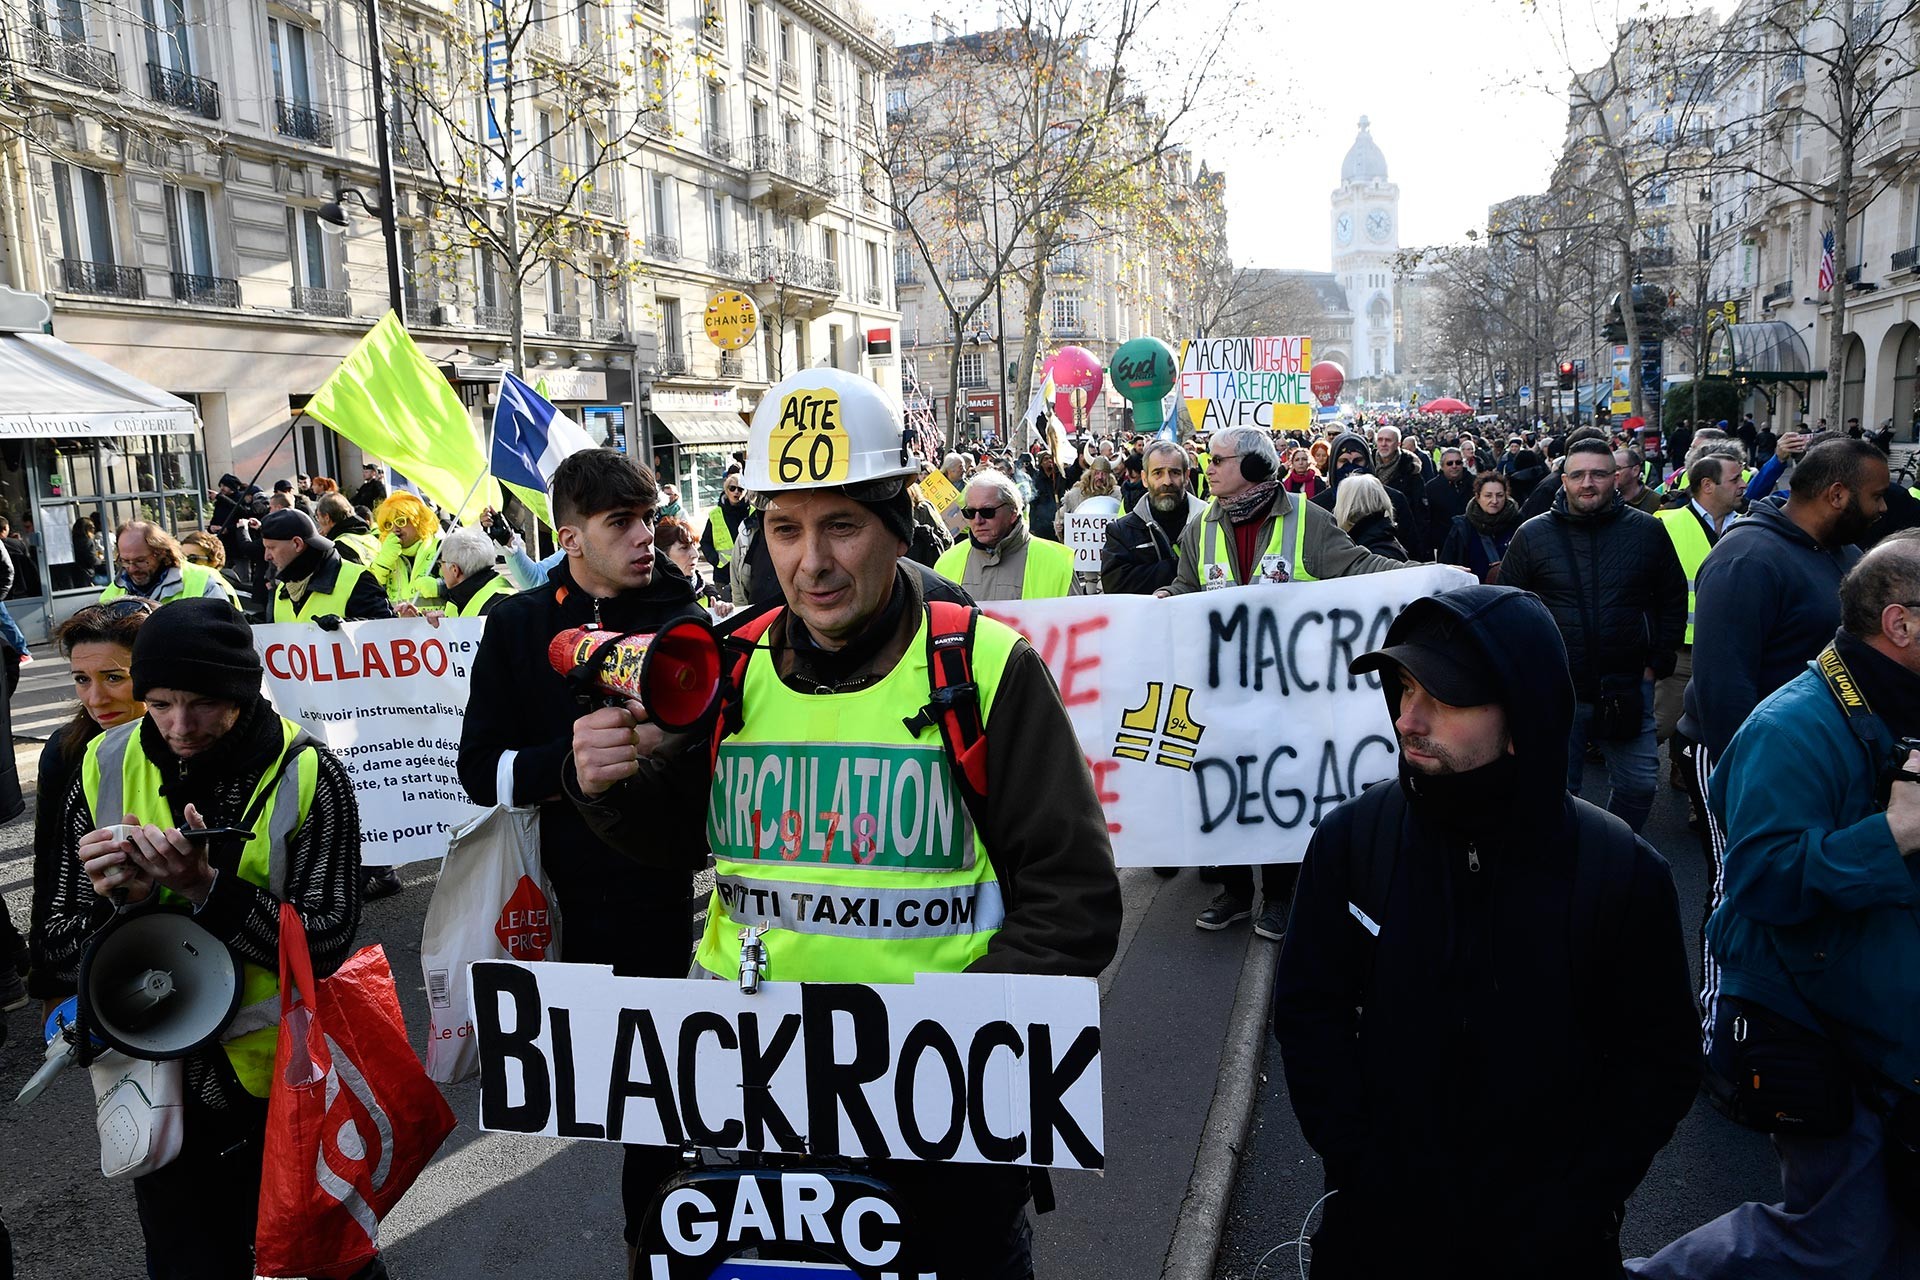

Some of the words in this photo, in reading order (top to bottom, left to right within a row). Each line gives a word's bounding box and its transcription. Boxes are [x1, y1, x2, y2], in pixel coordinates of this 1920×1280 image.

[705, 313, 755, 327] CHANGE
[1181, 339, 1254, 372] MACRON
[1118, 352, 1157, 381] Sud
[1182, 372, 1210, 399] ET
[1209, 371, 1237, 399] TA
[658, 390, 710, 405] CHANGE
[779, 431, 834, 482] 60
[1071, 517, 1108, 530] MACR
[934, 636, 962, 645] EASTPAK
[1209, 603, 1407, 696] MACRO
[264, 638, 449, 683] COLLABO
[449, 640, 471, 653] ne
[453, 662, 466, 678] la
[1835, 674, 1863, 706] Nikon
[299, 707, 310, 719] Le
[310, 708, 353, 722] pouvoir
[355, 702, 454, 718] instrumentalise
[455, 705, 465, 717] la
[1169, 716, 1188, 734] 94
[417, 737, 433, 749] du
[362, 758, 402, 772] dame
[405, 754, 436, 769] agée
[383, 776, 398, 787] ta
[401, 772, 433, 786] start
[434, 774, 449, 786] up
[402, 790, 416, 803] la
[418, 788, 456, 802] nation
[706, 754, 955, 858] CIRCULATION
[392, 824, 433, 843] pour
[751, 808, 877, 865] 1978
[717, 882, 781, 917] ROTTI
[791, 892, 975, 928] TAXI.COM
[661, 1172, 901, 1267] GARC
